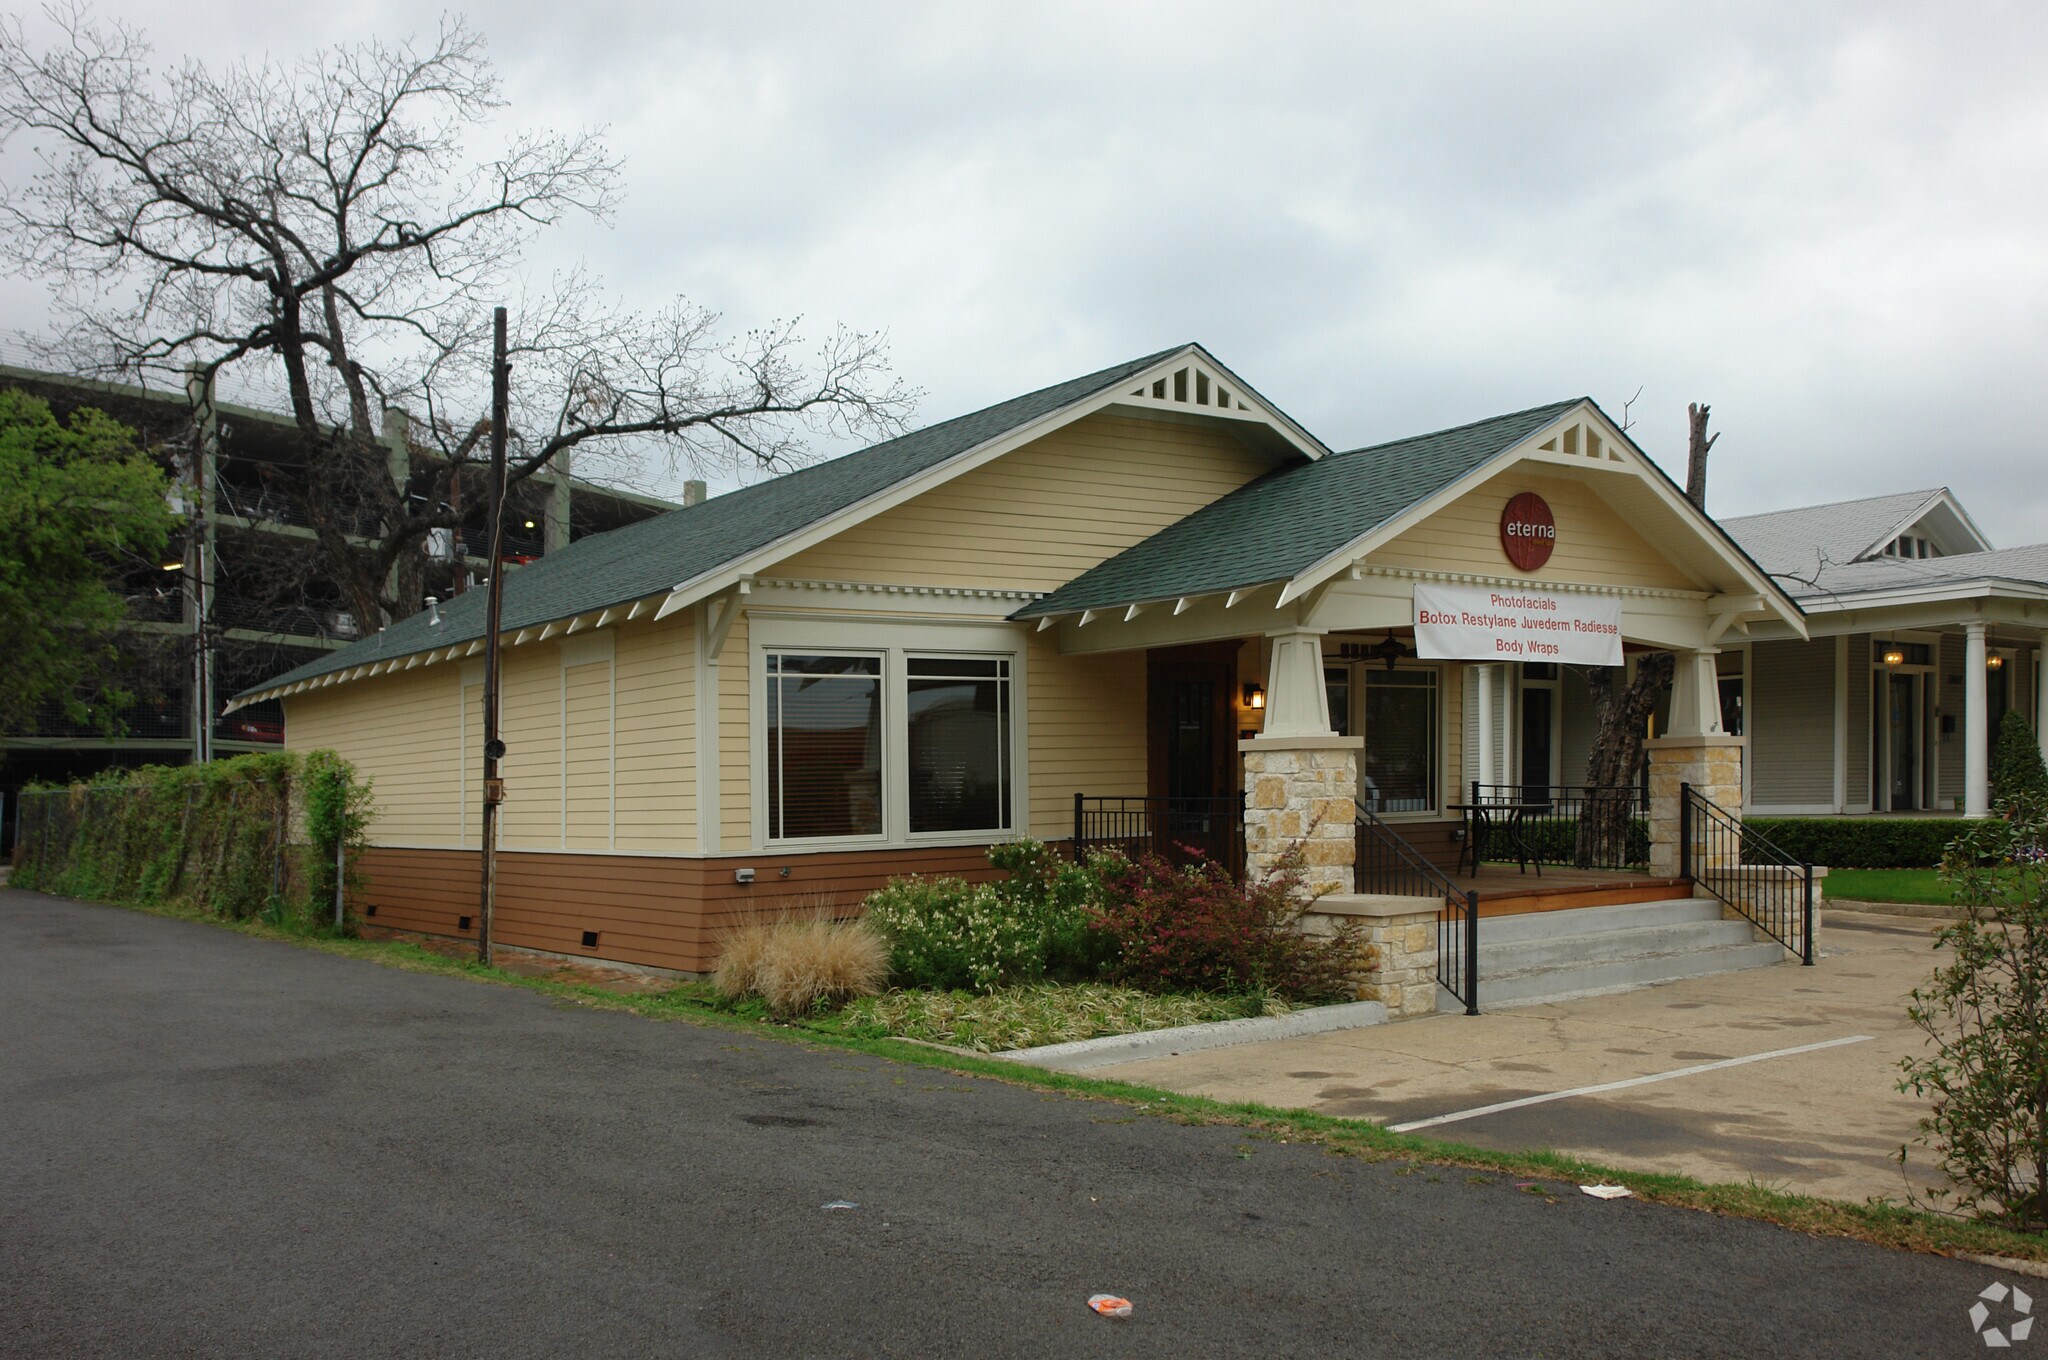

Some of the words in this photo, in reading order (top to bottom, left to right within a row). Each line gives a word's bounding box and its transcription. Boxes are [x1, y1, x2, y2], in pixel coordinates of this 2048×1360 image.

[1507, 520, 1555, 539] eterna
[1490, 593, 1557, 611] Photofacials
[1419, 610, 1457, 626] Botox
[1461, 611, 1517, 629] Restylane
[1521, 616, 1571, 632] Juvederm
[1574, 619, 1618, 635] Radiesse
[1495, 638, 1524, 655] Body
[1527, 640, 1559, 656] Wraps
